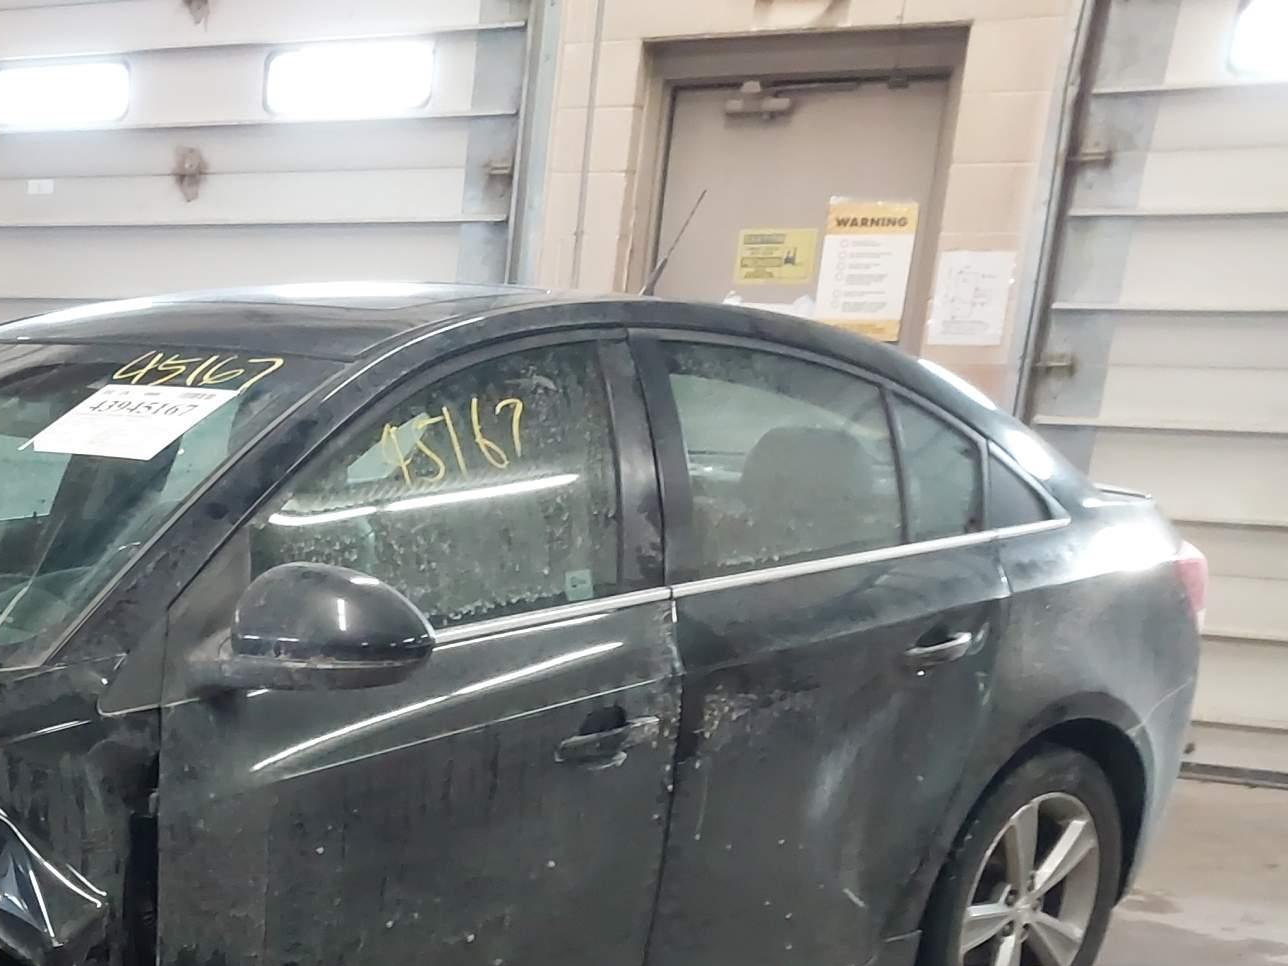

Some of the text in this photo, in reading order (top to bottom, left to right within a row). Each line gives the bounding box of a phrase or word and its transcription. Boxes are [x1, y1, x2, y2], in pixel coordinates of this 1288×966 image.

[835, 216, 909, 228] WARNING
[112, 350, 285, 395] 45167
[89, 401, 199, 416] 43945167
[382, 398, 523, 485] 45167
